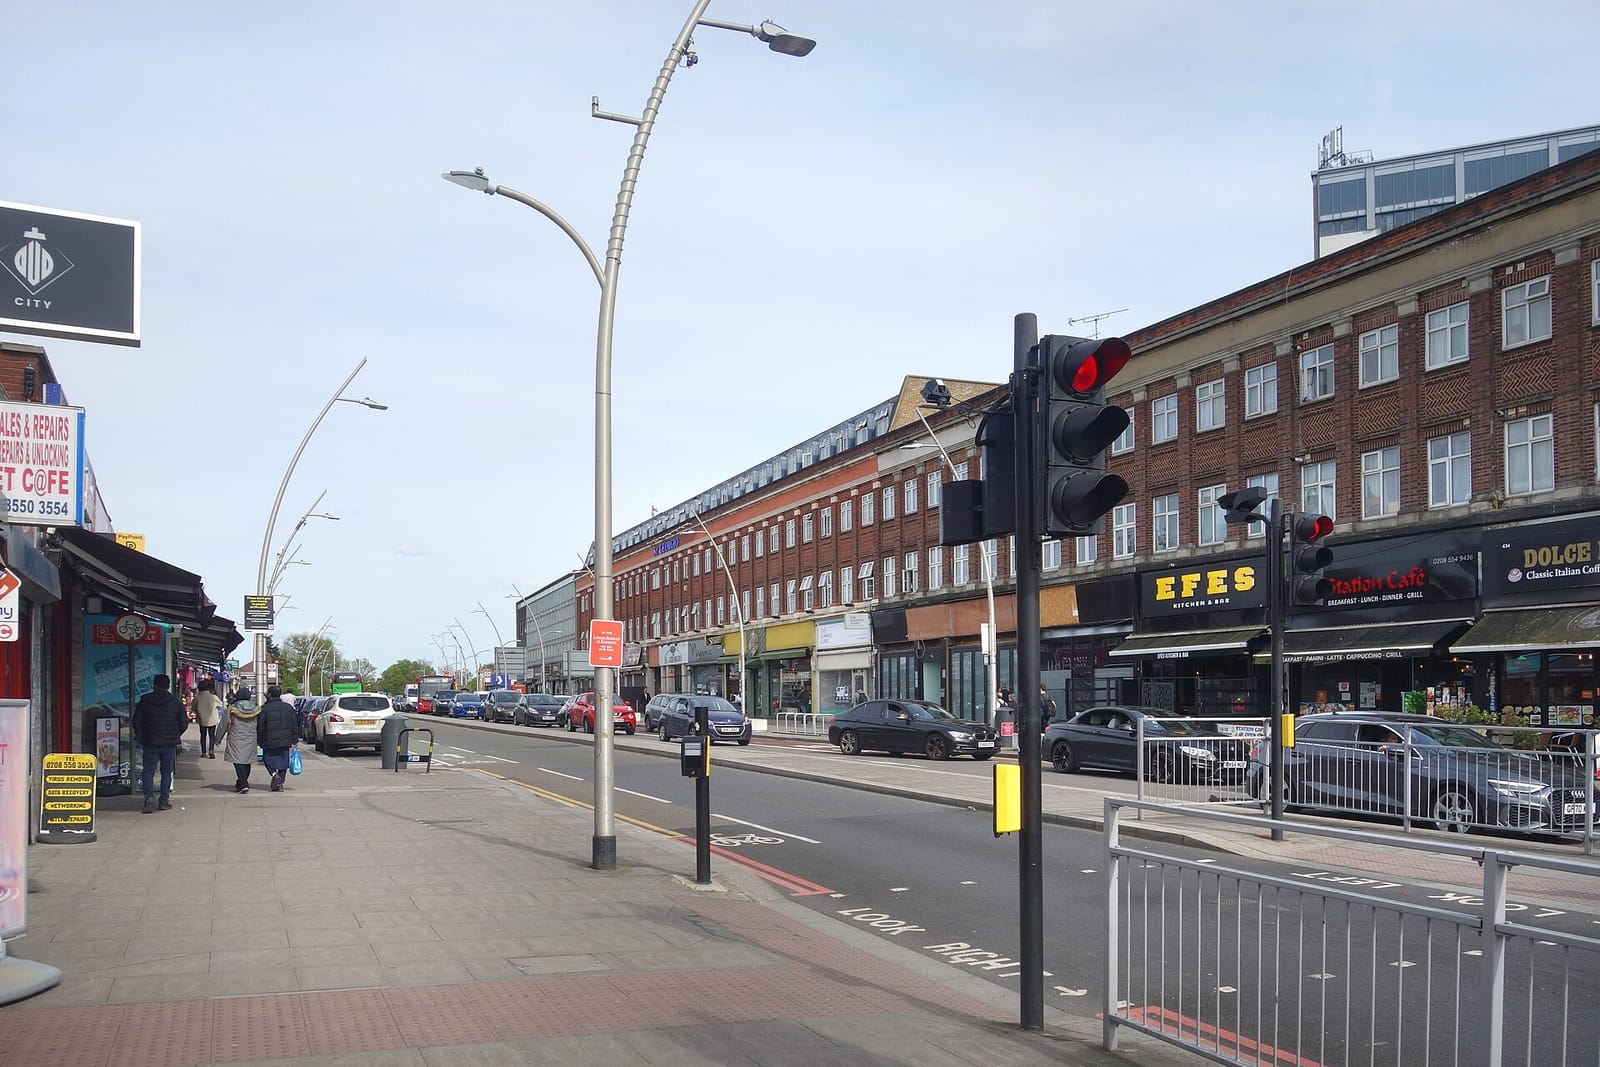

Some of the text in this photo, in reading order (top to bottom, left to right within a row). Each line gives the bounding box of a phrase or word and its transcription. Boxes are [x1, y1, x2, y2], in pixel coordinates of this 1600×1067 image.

[14, 297, 52, 309] CITY
[23, 414, 30, 439] &
[33, 414, 69, 442] REPAIRS
[0, 440, 69, 468] EPAIRS & UNLOCKING
[0, 466, 69, 497] T C@FE
[38, 500, 69, 516] 3554
[1433, 553, 1475, 565] 0208 554 9436
[1524, 541, 1591, 568] DOLCE
[1386, 566, 1425, 590] Café
[1526, 570, 1554, 580] Classic
[1555, 567, 1581, 577] Italian
[1156, 566, 1255, 601] EFES
[1173, 601, 1205, 609] KITCHEN
[1327, 591, 1424, 607] BREAKFAST LUNCH DINNER GRILL
[1305, 654, 1324, 662] PANINI
[1327, 653, 1343, 661] LATTE
[1346, 651, 1382, 660] CAPPUCCINO
[1386, 650, 1402, 658] GRILL
[1289, 871, 1402, 889] LEFT
[837, 907, 926, 936] LOOK
